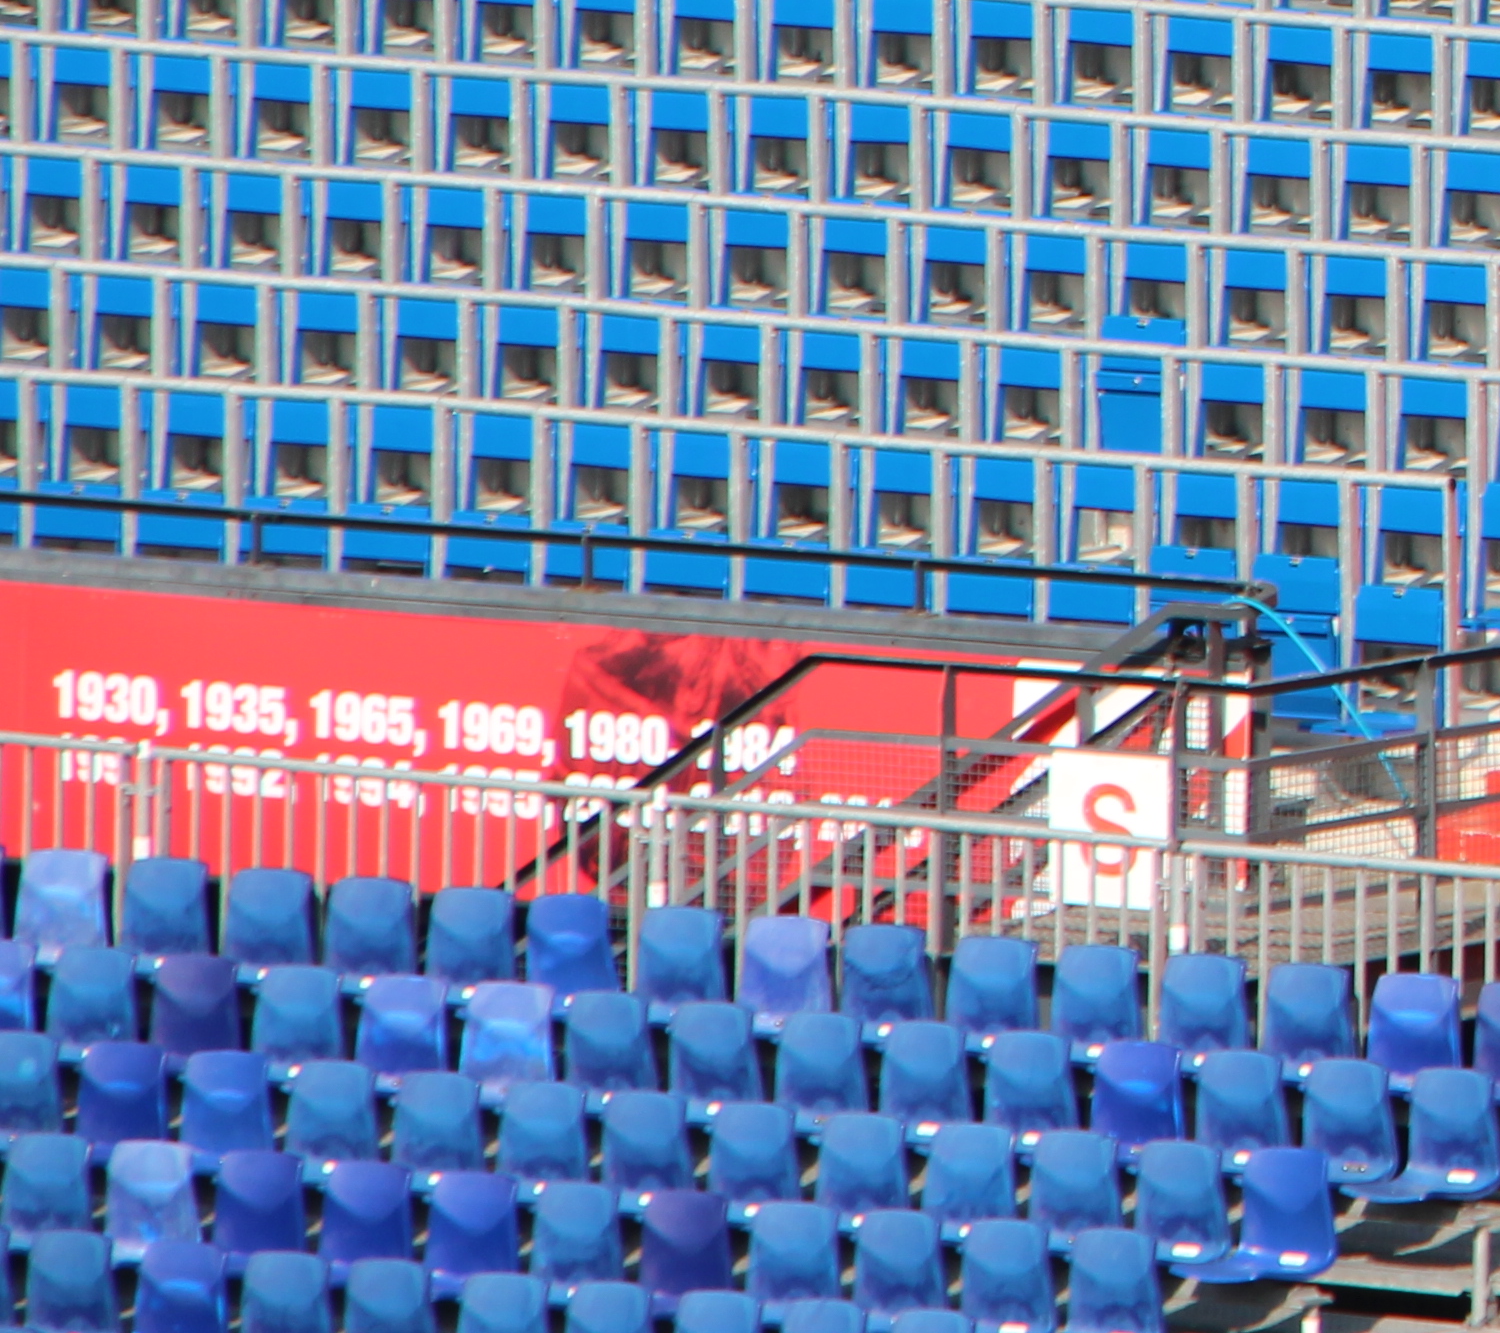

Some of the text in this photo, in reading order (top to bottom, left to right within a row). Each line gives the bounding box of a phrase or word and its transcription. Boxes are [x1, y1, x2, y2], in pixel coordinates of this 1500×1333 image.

[53, 669, 170, 736] 1930,
[180, 680, 299, 747] 1935,
[309, 689, 428, 757] 1965,
[437, 700, 556, 768] 1969,
[1080, 782, 1139, 878] S
